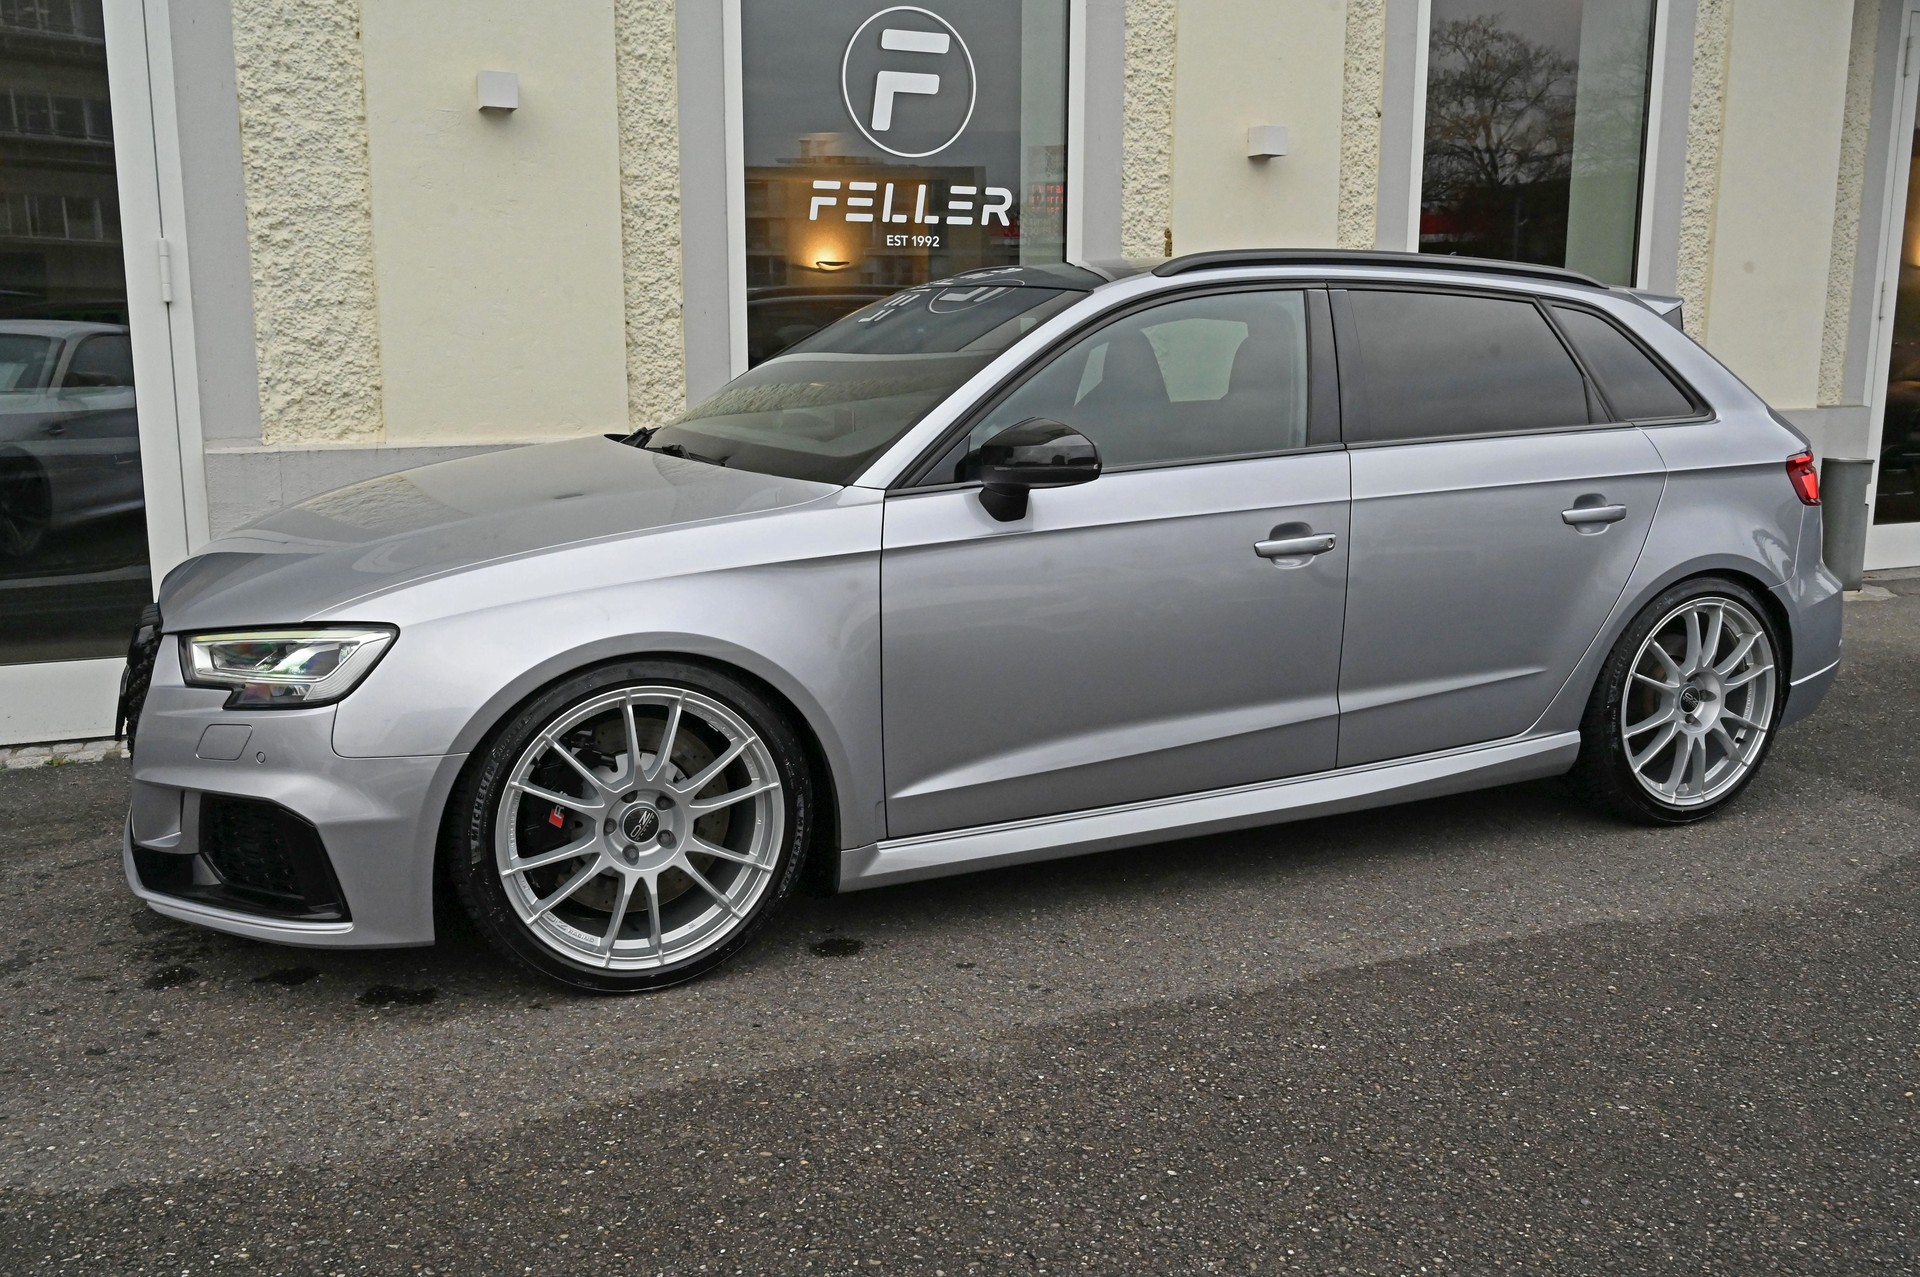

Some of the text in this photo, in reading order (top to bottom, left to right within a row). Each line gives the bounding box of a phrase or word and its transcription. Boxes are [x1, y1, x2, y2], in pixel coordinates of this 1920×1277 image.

[872, 28, 950, 131] F
[809, 180, 1013, 227] FELLER
[886, 235, 940, 248] EST 1992
[471, 765, 495, 842] MICHELIN
